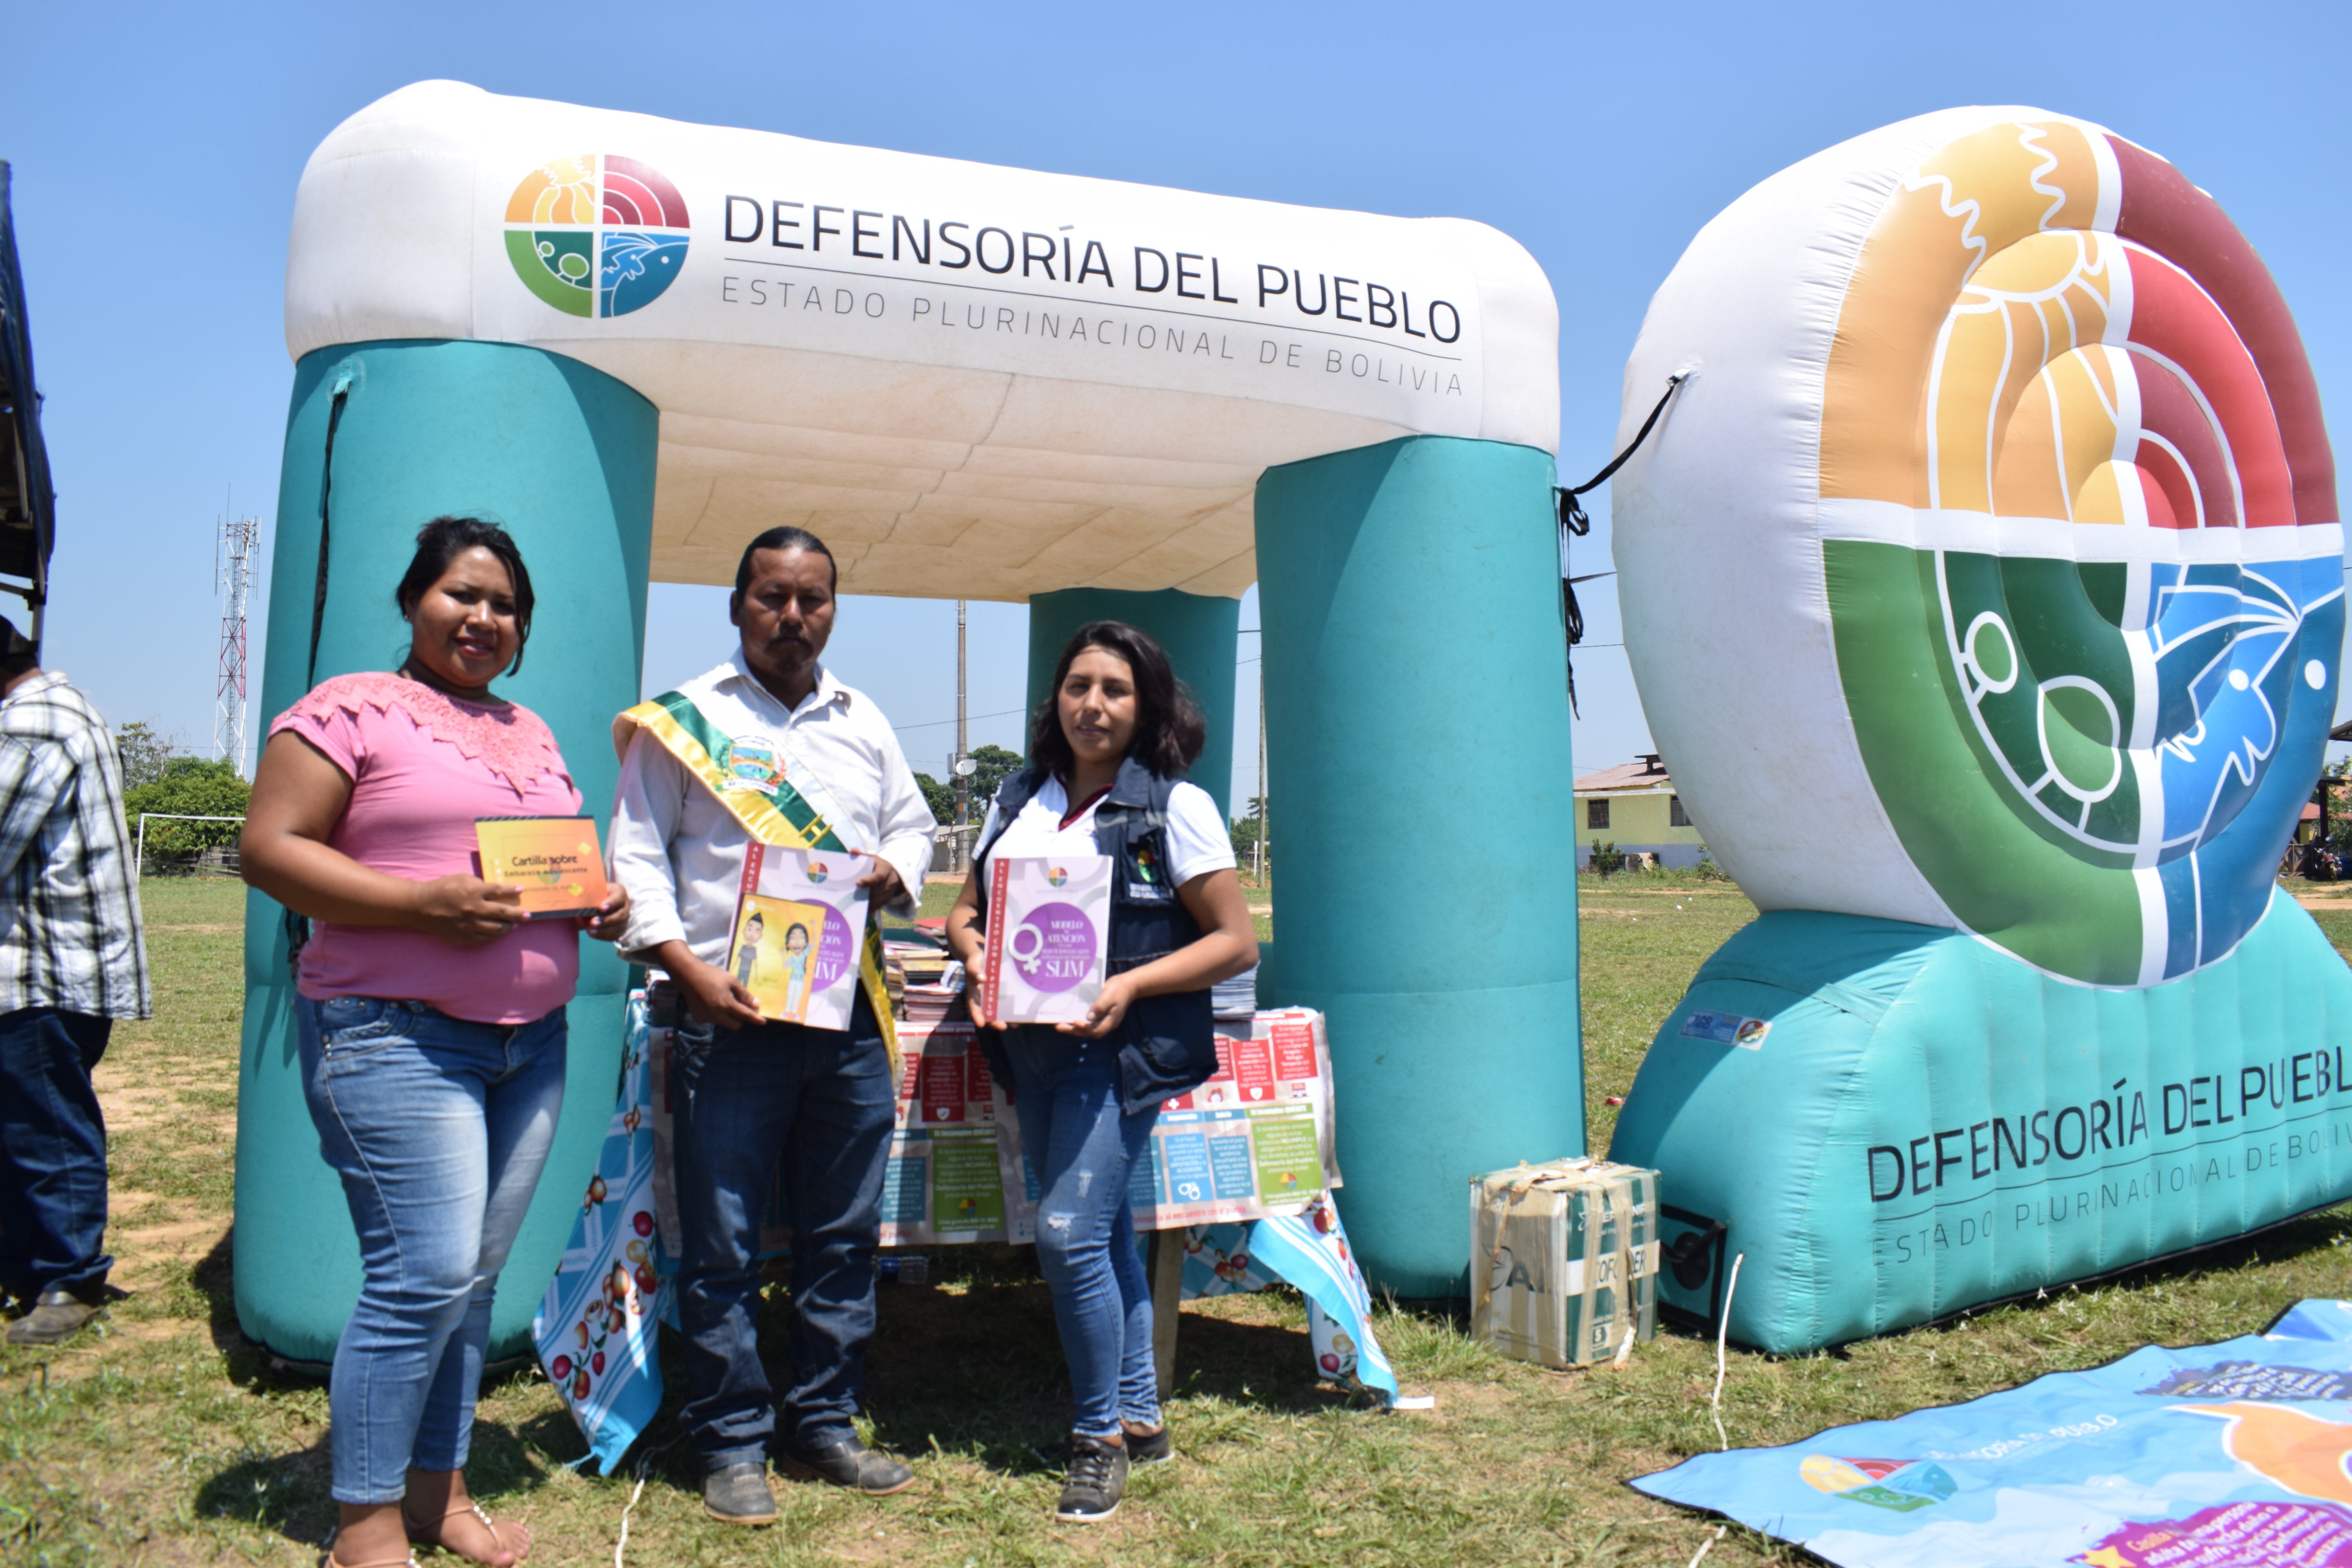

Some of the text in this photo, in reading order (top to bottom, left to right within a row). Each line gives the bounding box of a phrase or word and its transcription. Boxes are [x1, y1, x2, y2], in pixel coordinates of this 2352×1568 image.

[725, 194, 1461, 344] DEFENSORÍA DEL PUEBLO
[722, 276, 1463, 397] ESTADO PLURINACIONAL DE BOLIVIA
[512, 854, 578, 866] Cartilla sobre
[746, 862, 756, 891] ENCU
[993, 875, 1004, 936] ENCUENTRO
[821, 933, 841, 945] CIÓN
[823, 920, 840, 931] ELO
[1051, 920, 1084, 929] MODELO
[1045, 960, 1084, 977] SLIM
[986, 975, 995, 1016] PUEBLO
[1867, 1078, 2149, 1203] DEFENSORÍA
[2163, 1074, 2234, 1136] DEL
[1873, 1210, 1993, 1267] ESTADO
[2016, 1154, 2237, 1231] PLURINACIONAL
[2247, 1142, 2279, 1172] DE
